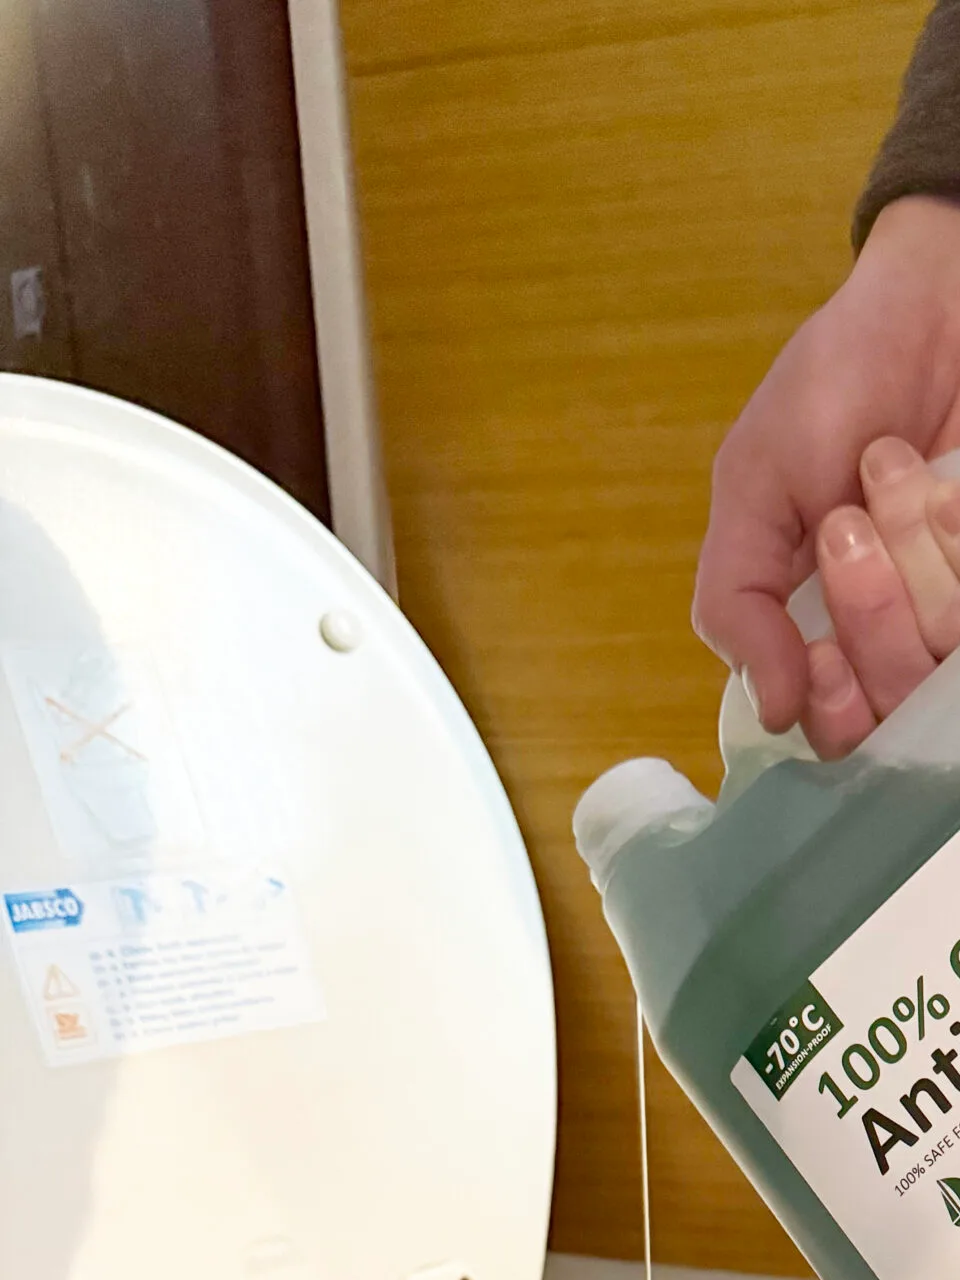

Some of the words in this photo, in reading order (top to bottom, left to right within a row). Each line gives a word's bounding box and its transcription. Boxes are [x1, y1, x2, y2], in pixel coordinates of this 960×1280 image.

[11, 897, 79, 922] JABSCO
[765, 1004, 825, 1075] -70°C
[776, 1023, 832, 1091] EXPANSION-PROOF
[818, 975, 950, 1120] 100%
[894, 1162, 926, 1197] 100%
[924, 1135, 954, 1167] SAFE
